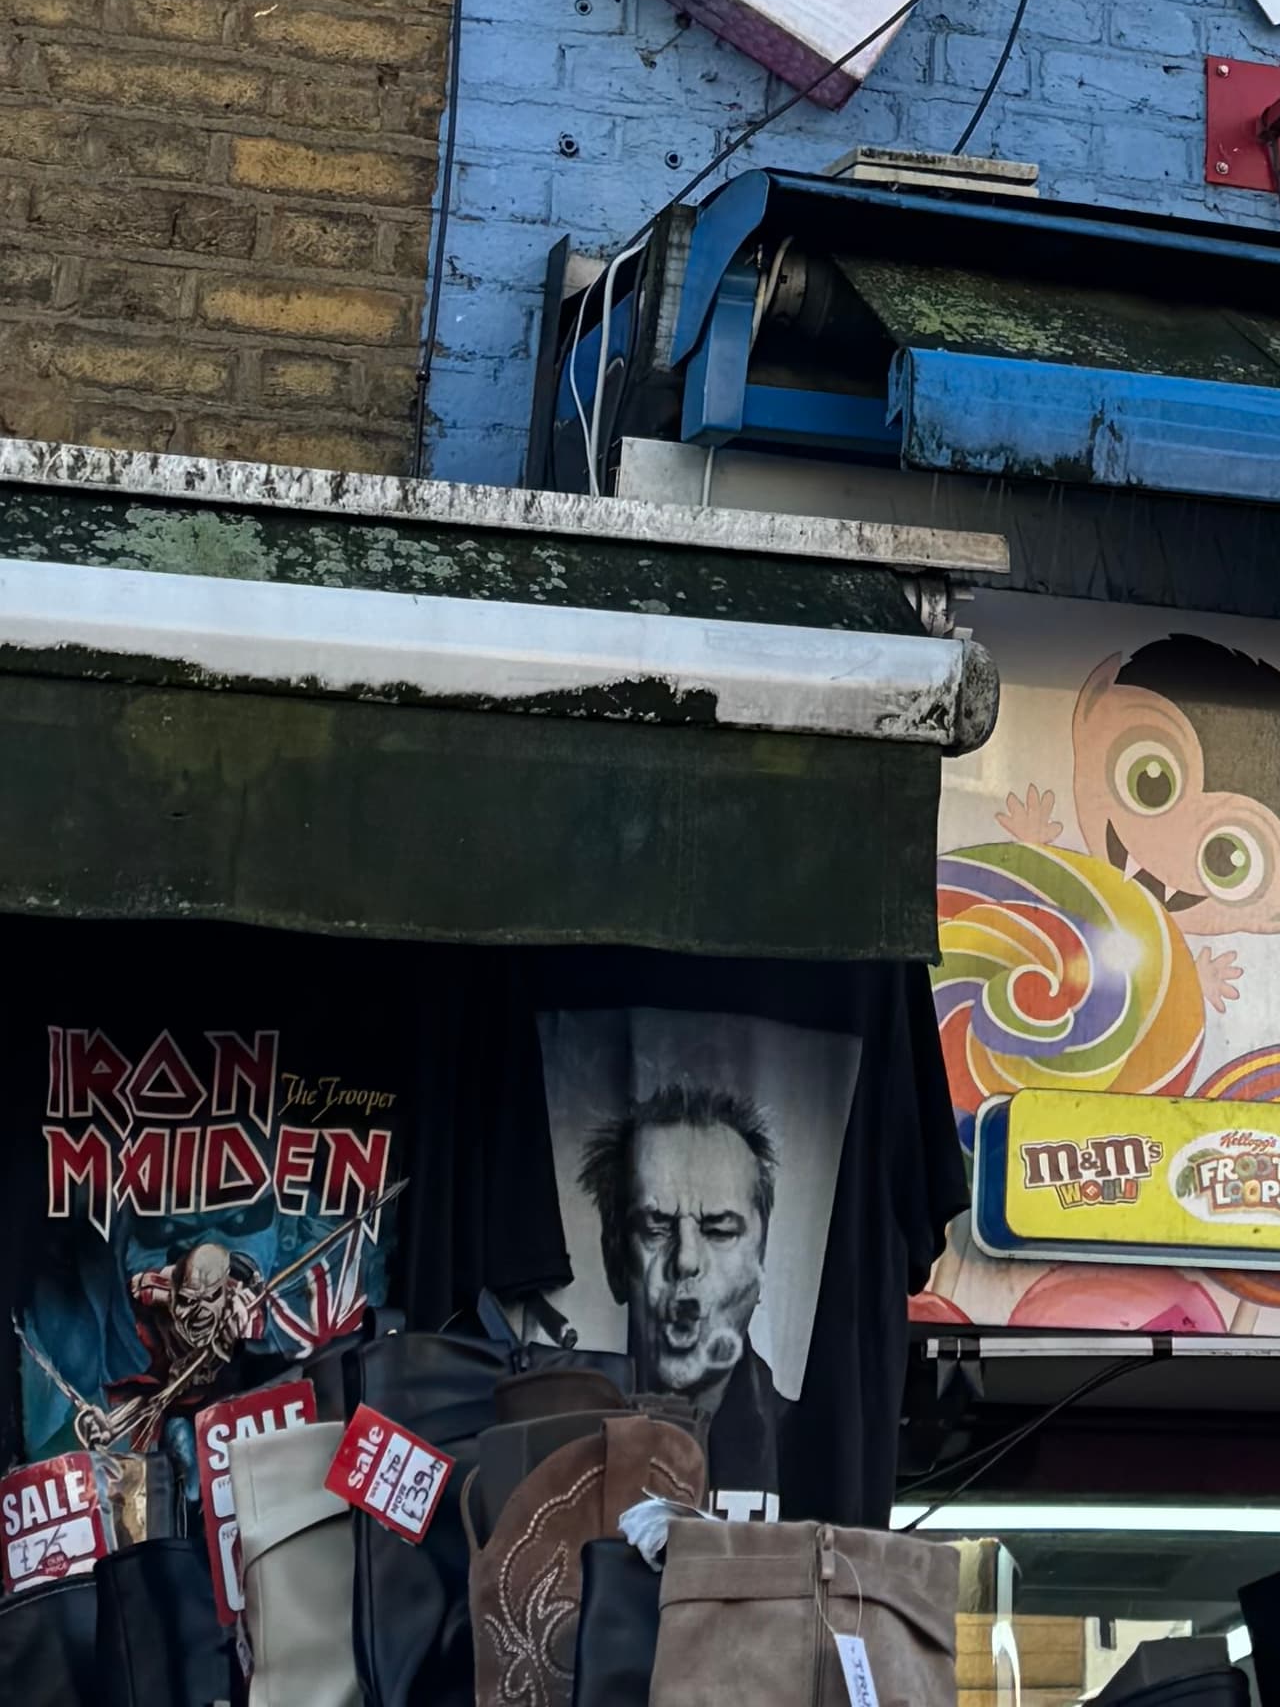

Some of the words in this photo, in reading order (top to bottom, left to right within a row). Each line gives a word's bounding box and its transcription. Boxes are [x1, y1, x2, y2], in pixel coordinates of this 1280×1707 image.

[46, 1025, 280, 1140] IRON
[278, 1072, 316, 1116] The
[312, 1075, 397, 1123] Trooper
[1220, 1129, 1277, 1154] Kellogg's
[42, 1122, 392, 1246] MAIDEN
[2, 1469, 90, 1536] SALE
